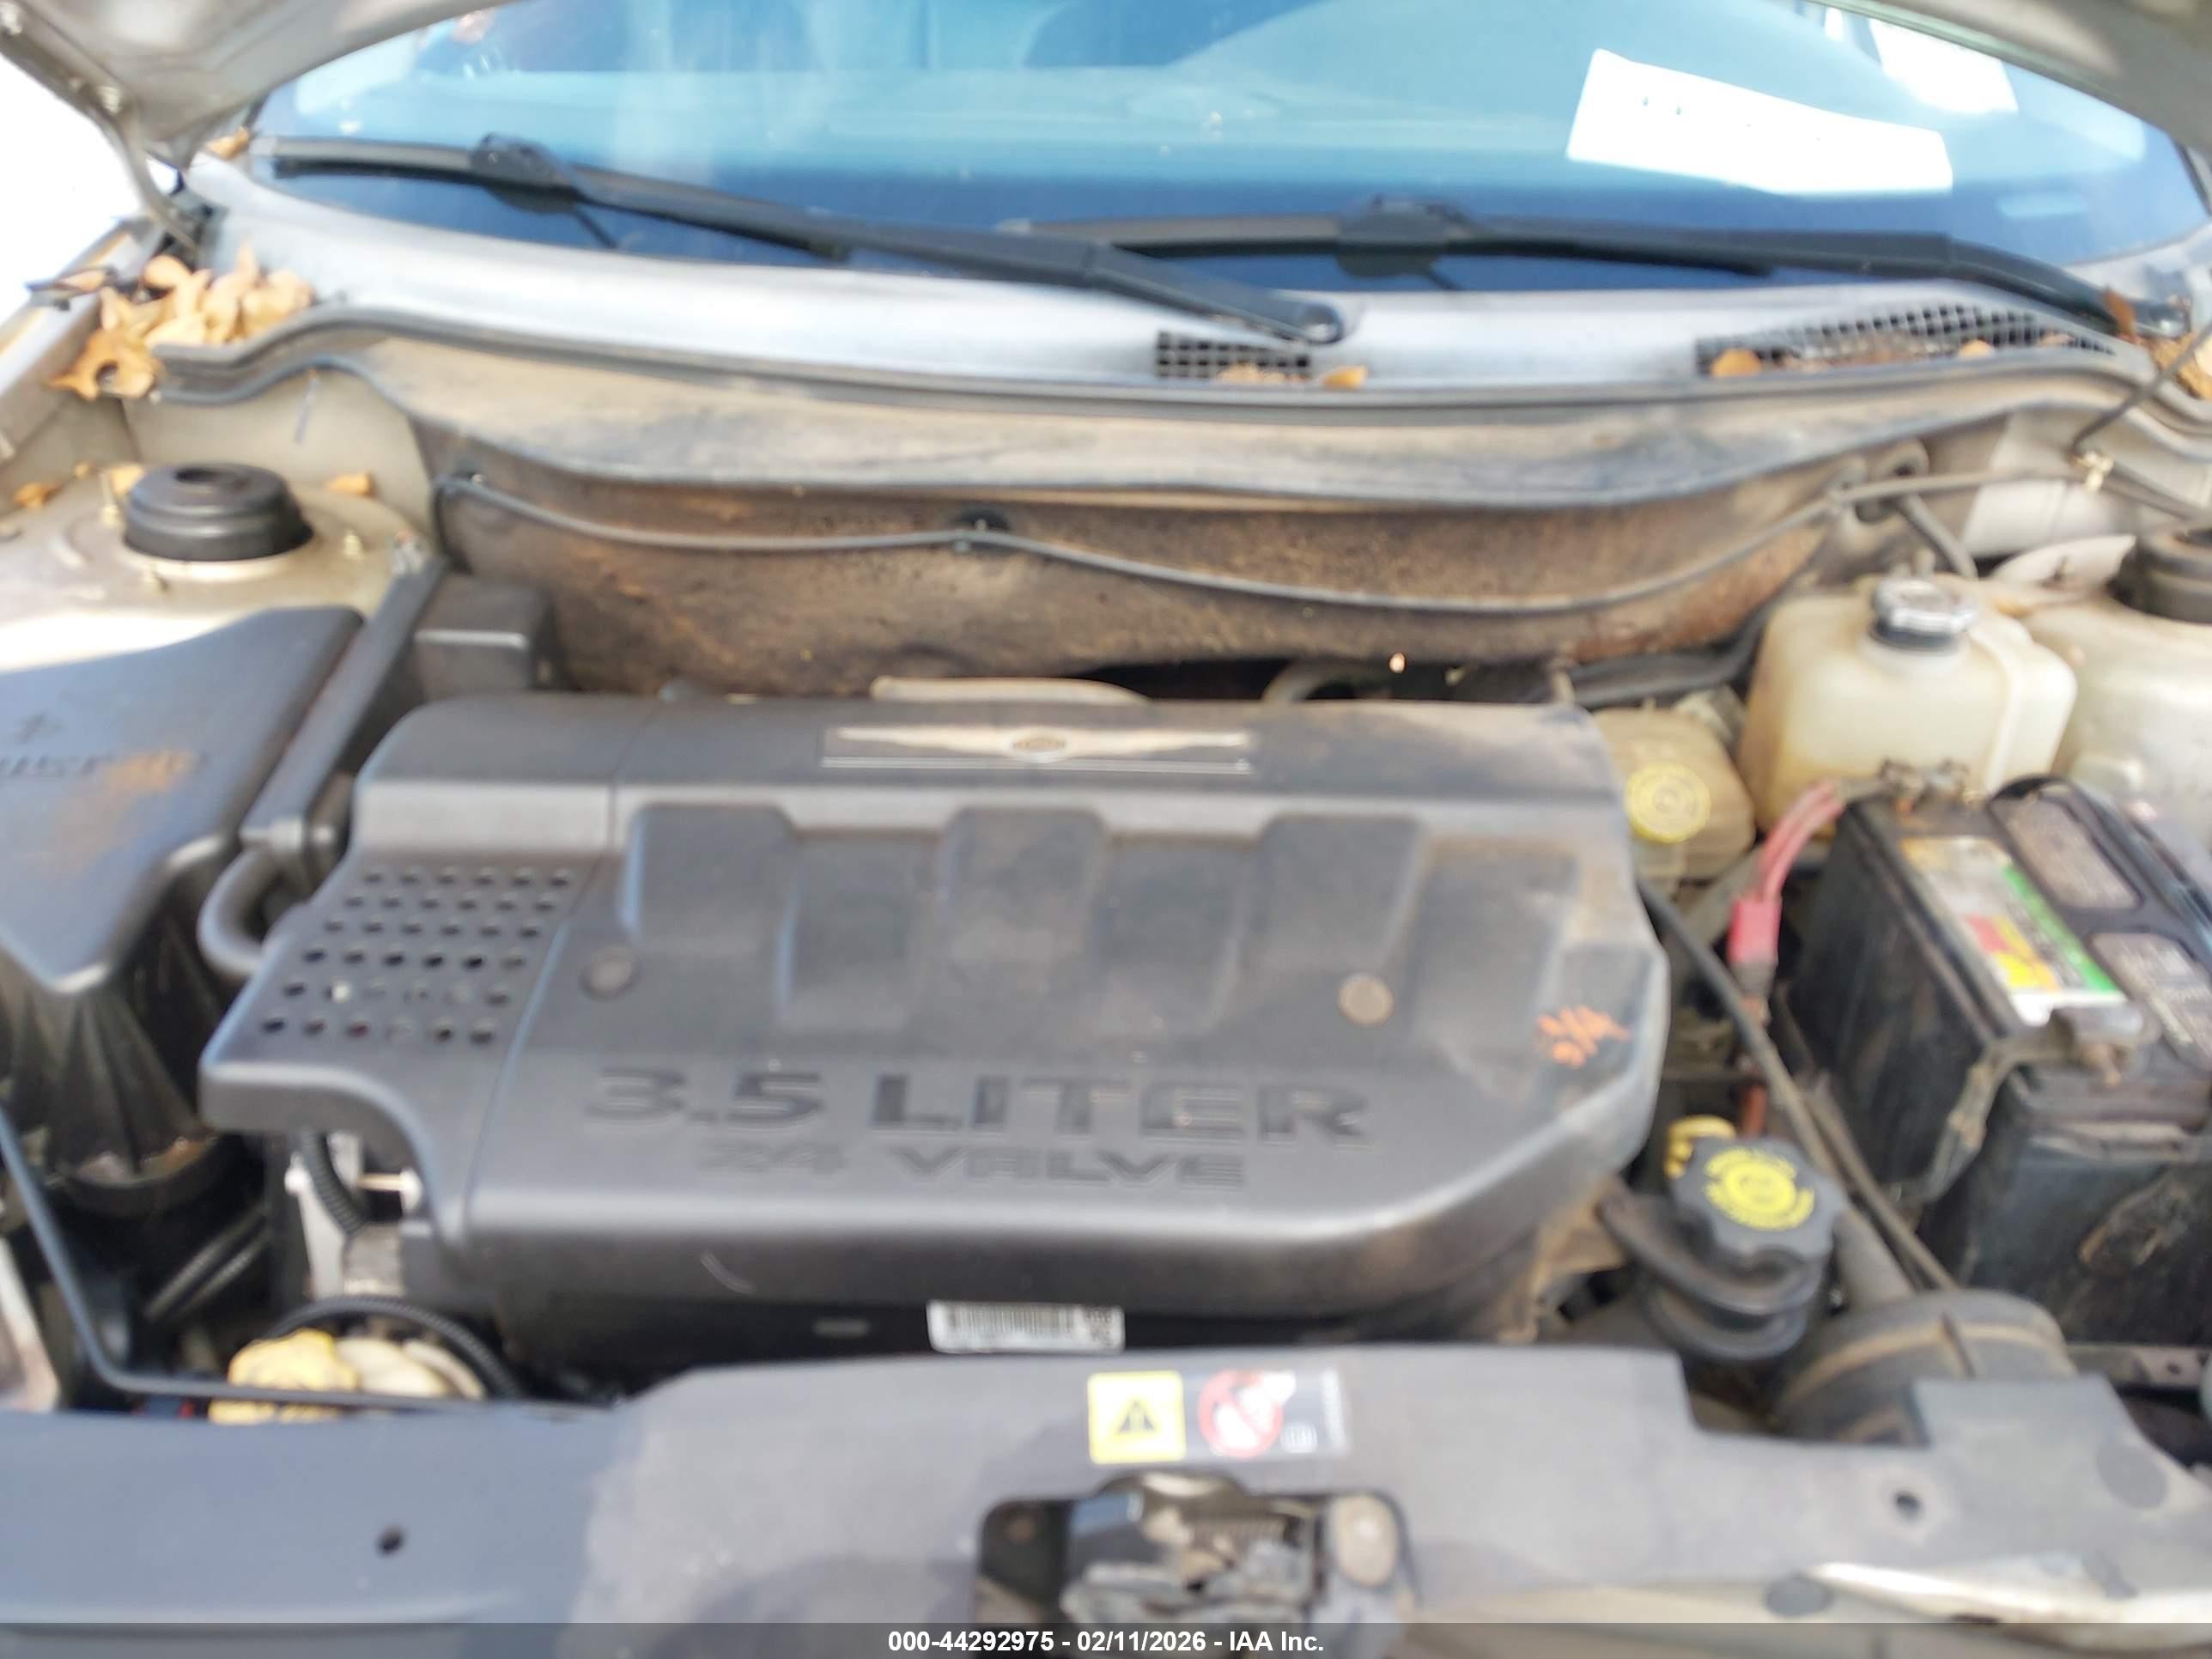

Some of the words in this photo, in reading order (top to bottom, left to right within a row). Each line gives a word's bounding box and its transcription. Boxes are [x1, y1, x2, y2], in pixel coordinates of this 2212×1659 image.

[585, 1066, 826, 1130] 3.5
[870, 1072, 1372, 1149] LITER
[888, 1144, 1248, 1191] VALVE
